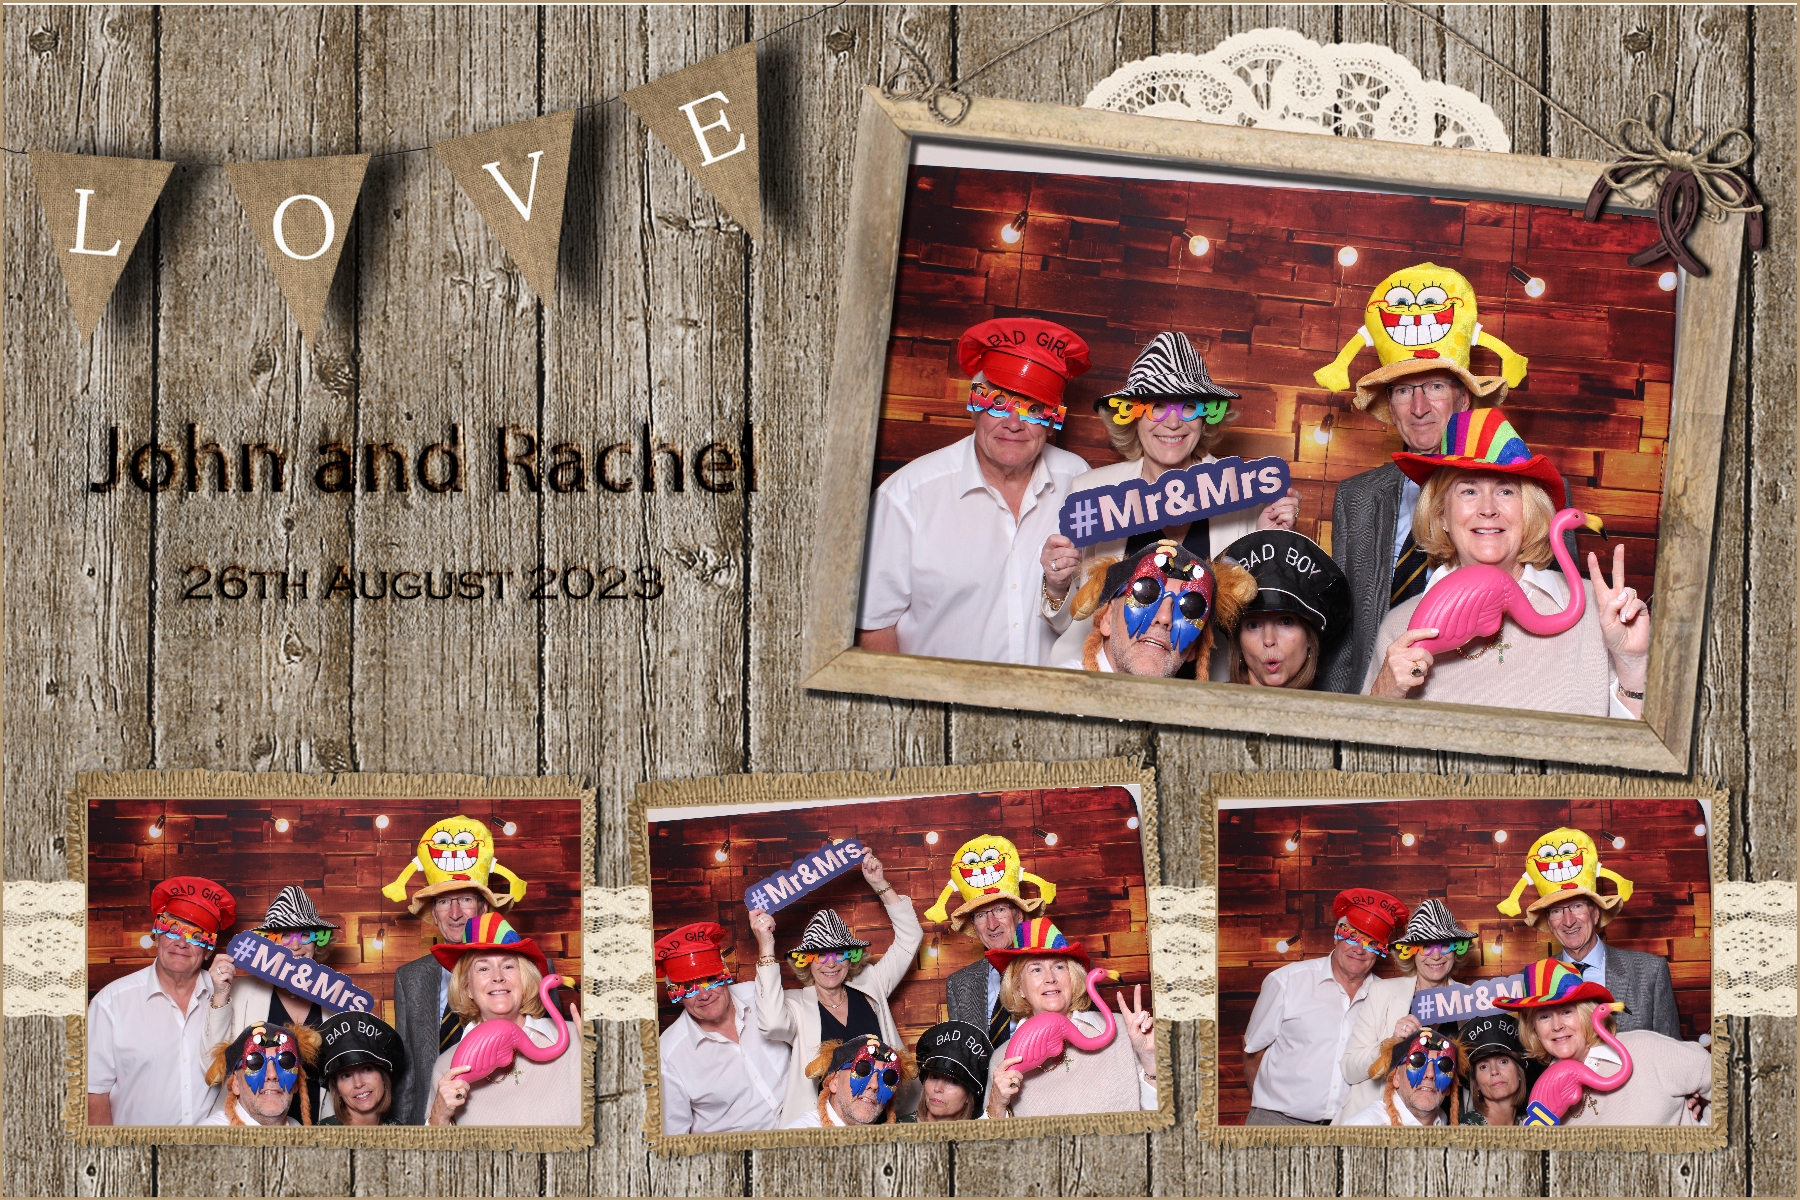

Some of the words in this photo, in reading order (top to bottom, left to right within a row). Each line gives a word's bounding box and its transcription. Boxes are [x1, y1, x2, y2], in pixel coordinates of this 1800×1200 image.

[1070, 466, 1282, 538] #Mr&Mrs
[1286, 547, 1321, 579] BOY
[751, 843, 862, 910] #Mr&Mrs
[233, 937, 368, 1012] #Mr&Mrs
[1418, 980, 1524, 1020] #Mr&M
[325, 1022, 350, 1045] BAD
[357, 1021, 382, 1040] BOY
[937, 1030, 960, 1045] BAD
[965, 1036, 987, 1059] BOY
[1468, 1021, 1493, 1040] BAD
